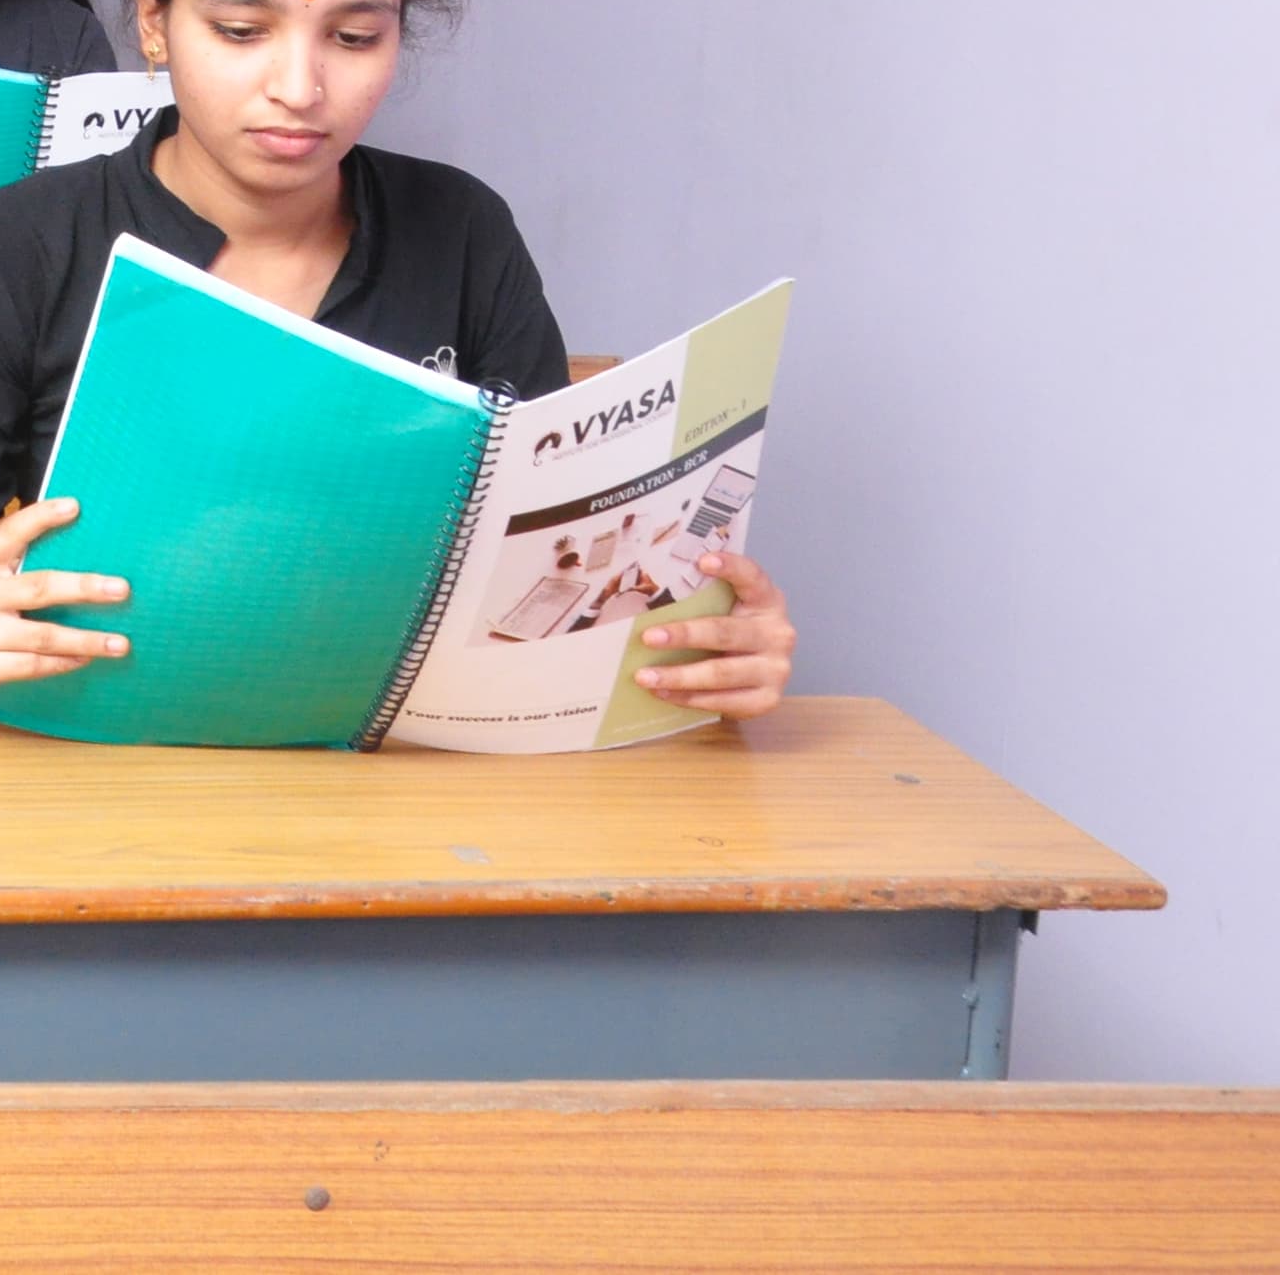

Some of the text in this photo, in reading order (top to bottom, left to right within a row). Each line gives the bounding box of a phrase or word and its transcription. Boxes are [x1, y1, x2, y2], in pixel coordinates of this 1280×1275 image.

[572, 378, 676, 445] VYASA
[684, 409, 729, 444] EDITION
[589, 467, 676, 512] FOUNDATION
[683, 449, 709, 473] BCR
[404, 709, 444, 720] Your
[508, 714, 520, 722] is
[524, 713, 551, 721] our
[555, 705, 598, 718] vision
